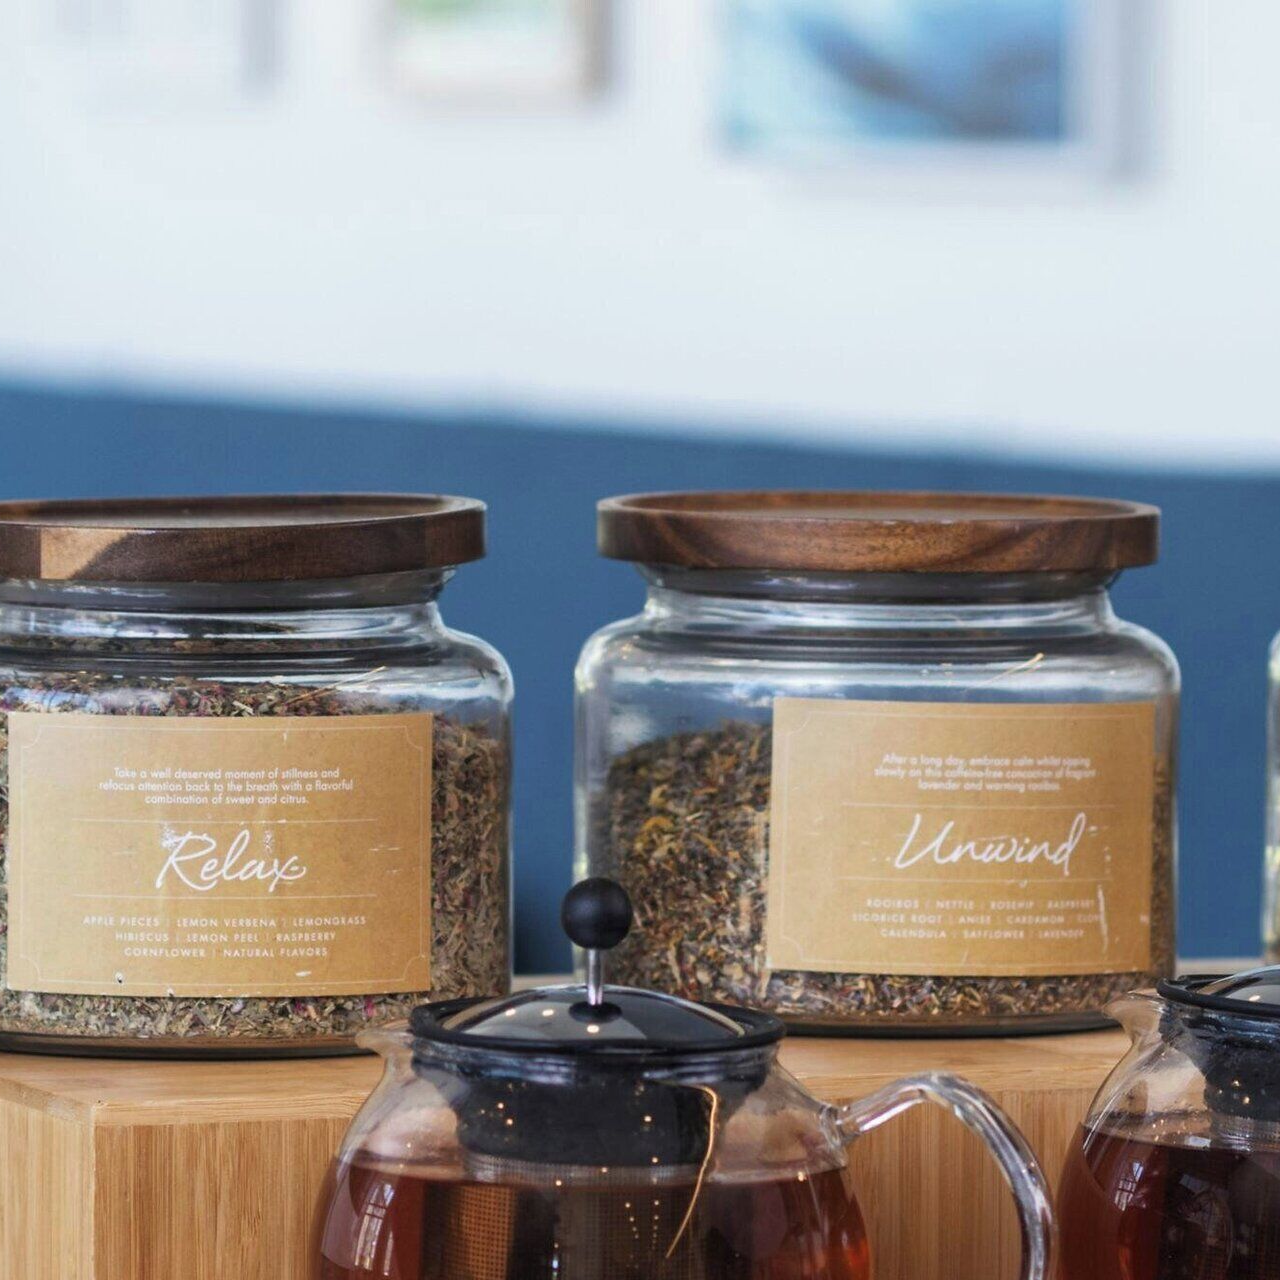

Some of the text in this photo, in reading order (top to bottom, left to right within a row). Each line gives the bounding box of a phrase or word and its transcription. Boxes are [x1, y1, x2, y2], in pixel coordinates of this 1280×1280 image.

[883, 753, 906, 764] After
[921, 754, 942, 767] long
[970, 755, 1010, 766] embrace
[1012, 756, 1034, 766] calm
[114, 767, 339, 779] Take a well deserved moment of stillness and
[874, 766, 904, 778] slowly
[909, 769, 921, 777] on
[925, 767, 942, 777] this
[945, 766, 1003, 778] caffeine-free
[1055, 768, 1064, 778] of
[99, 779, 353, 791] refocus attention back to the breath with a flavorful
[918, 779, 959, 790] lavender
[963, 779, 982, 790] and
[985, 781, 1025, 793] warming
[144, 793, 308, 804] combination of sweet and citrus.
[895, 812, 1086, 877] Unwind
[155, 829, 307, 892] Relax
[866, 899, 919, 909] ROOIBOS
[936, 900, 974, 910] NETTLE
[990, 900, 1034, 910] ROSEHIP
[82, 916, 366, 927] APPLE PIECES LEMON VERBENA LEMONGRASS
[852, 914, 905, 923] LICORICE
[911, 914, 942, 924] ROOT
[959, 915, 991, 925] ANISE
[115, 932, 336, 942] HIBISCUS LEMON PEEL RASPBERRY
[880, 928, 1083, 939] CALENDULA SAFFLOWER LAVENDER
[124, 947, 328, 957] CORNFLOWER NATURAL FLAVORS
